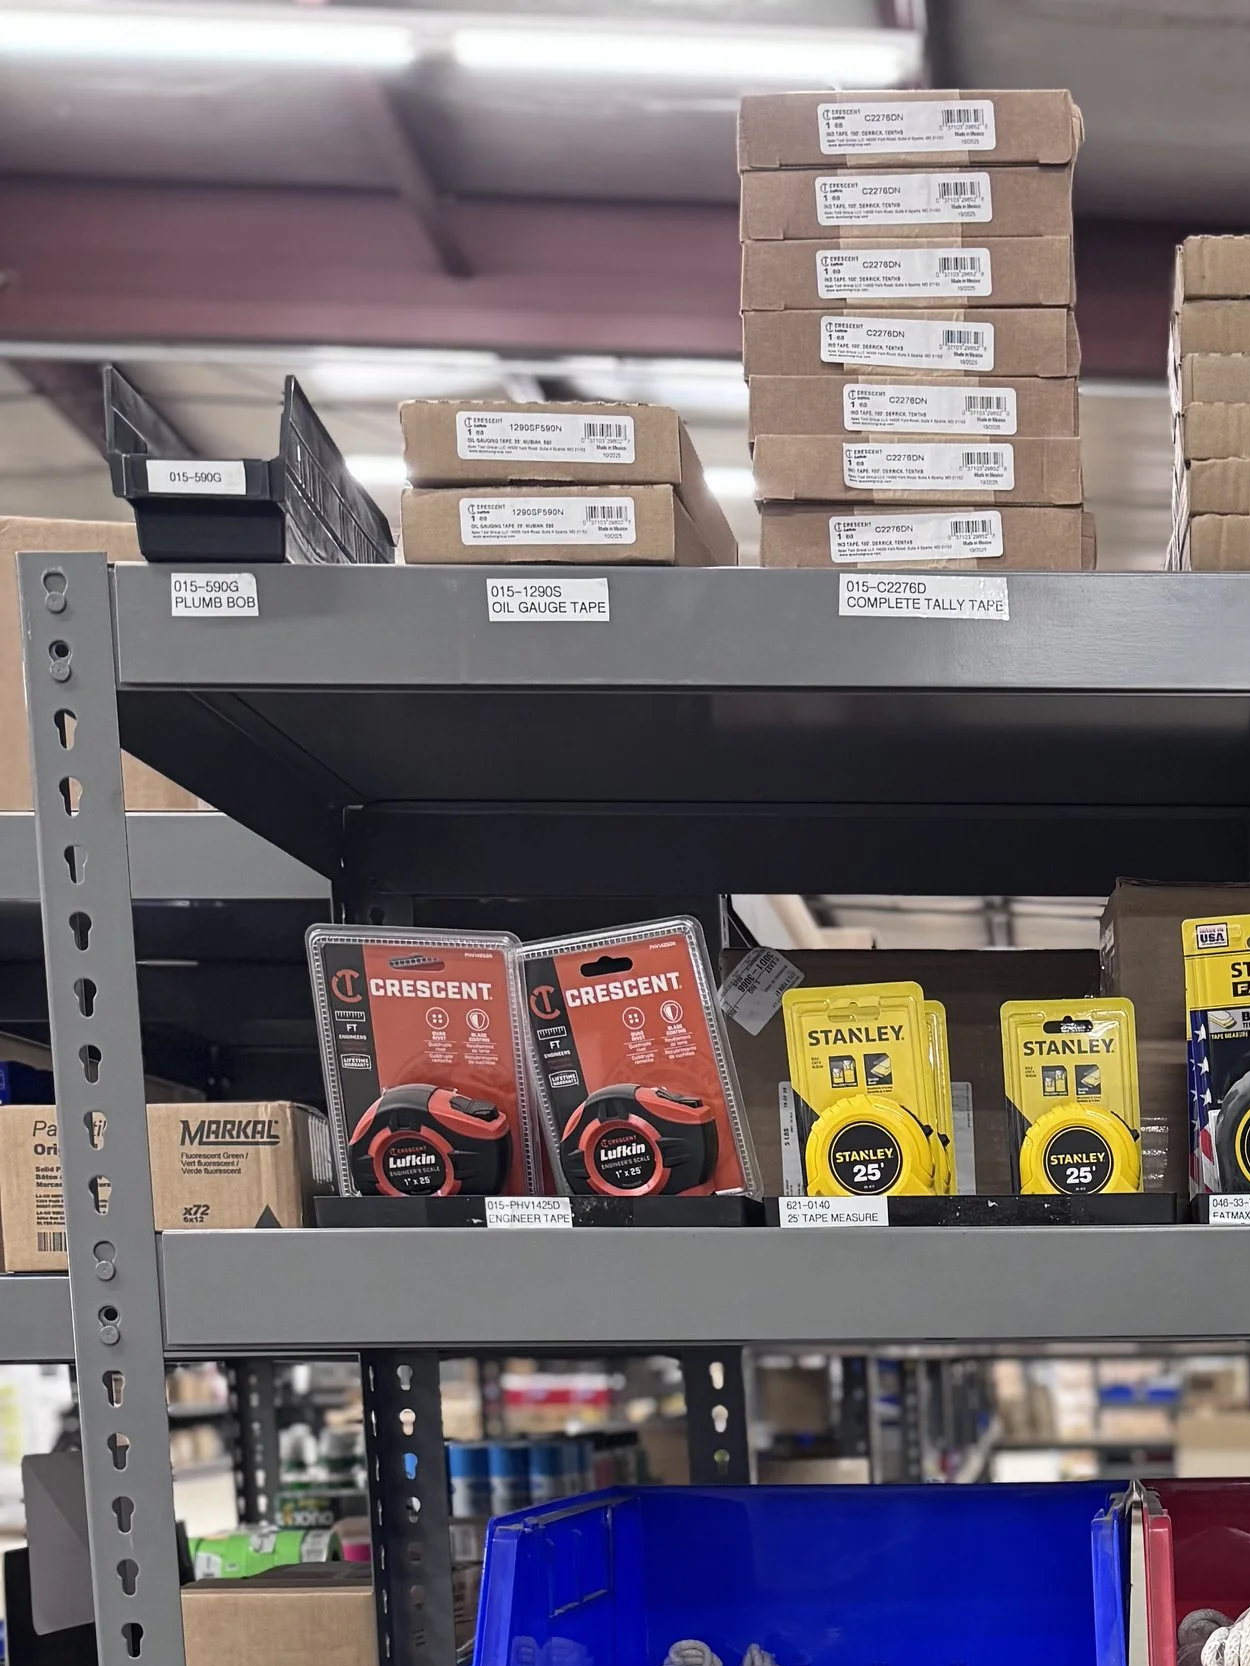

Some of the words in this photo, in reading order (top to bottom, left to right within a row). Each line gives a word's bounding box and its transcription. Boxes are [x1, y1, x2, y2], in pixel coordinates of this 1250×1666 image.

[169, 471, 221, 483] 015-590G
[174, 580, 238, 593] 015-590G
[492, 585, 561, 598] 015-1290S
[847, 581, 926, 594] 015-C2276D
[175, 596, 222, 610] PLUMB
[227, 596, 255, 610] BOB
[492, 601, 517, 614] OIL
[521, 601, 566, 614] GAUGE
[571, 601, 606, 614] TAPE
[847, 597, 920, 610] COMPLETE
[925, 598, 966, 611] TALLY
[969, 600, 1003, 612] TAPE
[370, 979, 490, 1000] CRESCENT
[566, 972, 680, 1008] CRESCENT
[808, 1025, 904, 1046] STANLEY
[1024, 1039, 1114, 1056] STANLEY
[180, 1120, 280, 1146] MARKAL
[600, 1143, 645, 1161] Lufkin
[836, 1148, 893, 1163] STANLEY
[1050, 1152, 1105, 1164] STANLEY
[389, 1154, 435, 1168] Lufkin
[853, 1163, 885, 1182] 25'
[1066, 1167, 1096, 1183] 25'
[487, 1201, 560, 1210] 015-PHV1425D
[787, 1200, 830, 1211] 621-0140
[489, 1213, 541, 1223] ENGINEER
[545, 1213, 569, 1223] TAPE
[802, 1213, 828, 1223] TAPE
[831, 1212, 878, 1222] MEASURE
